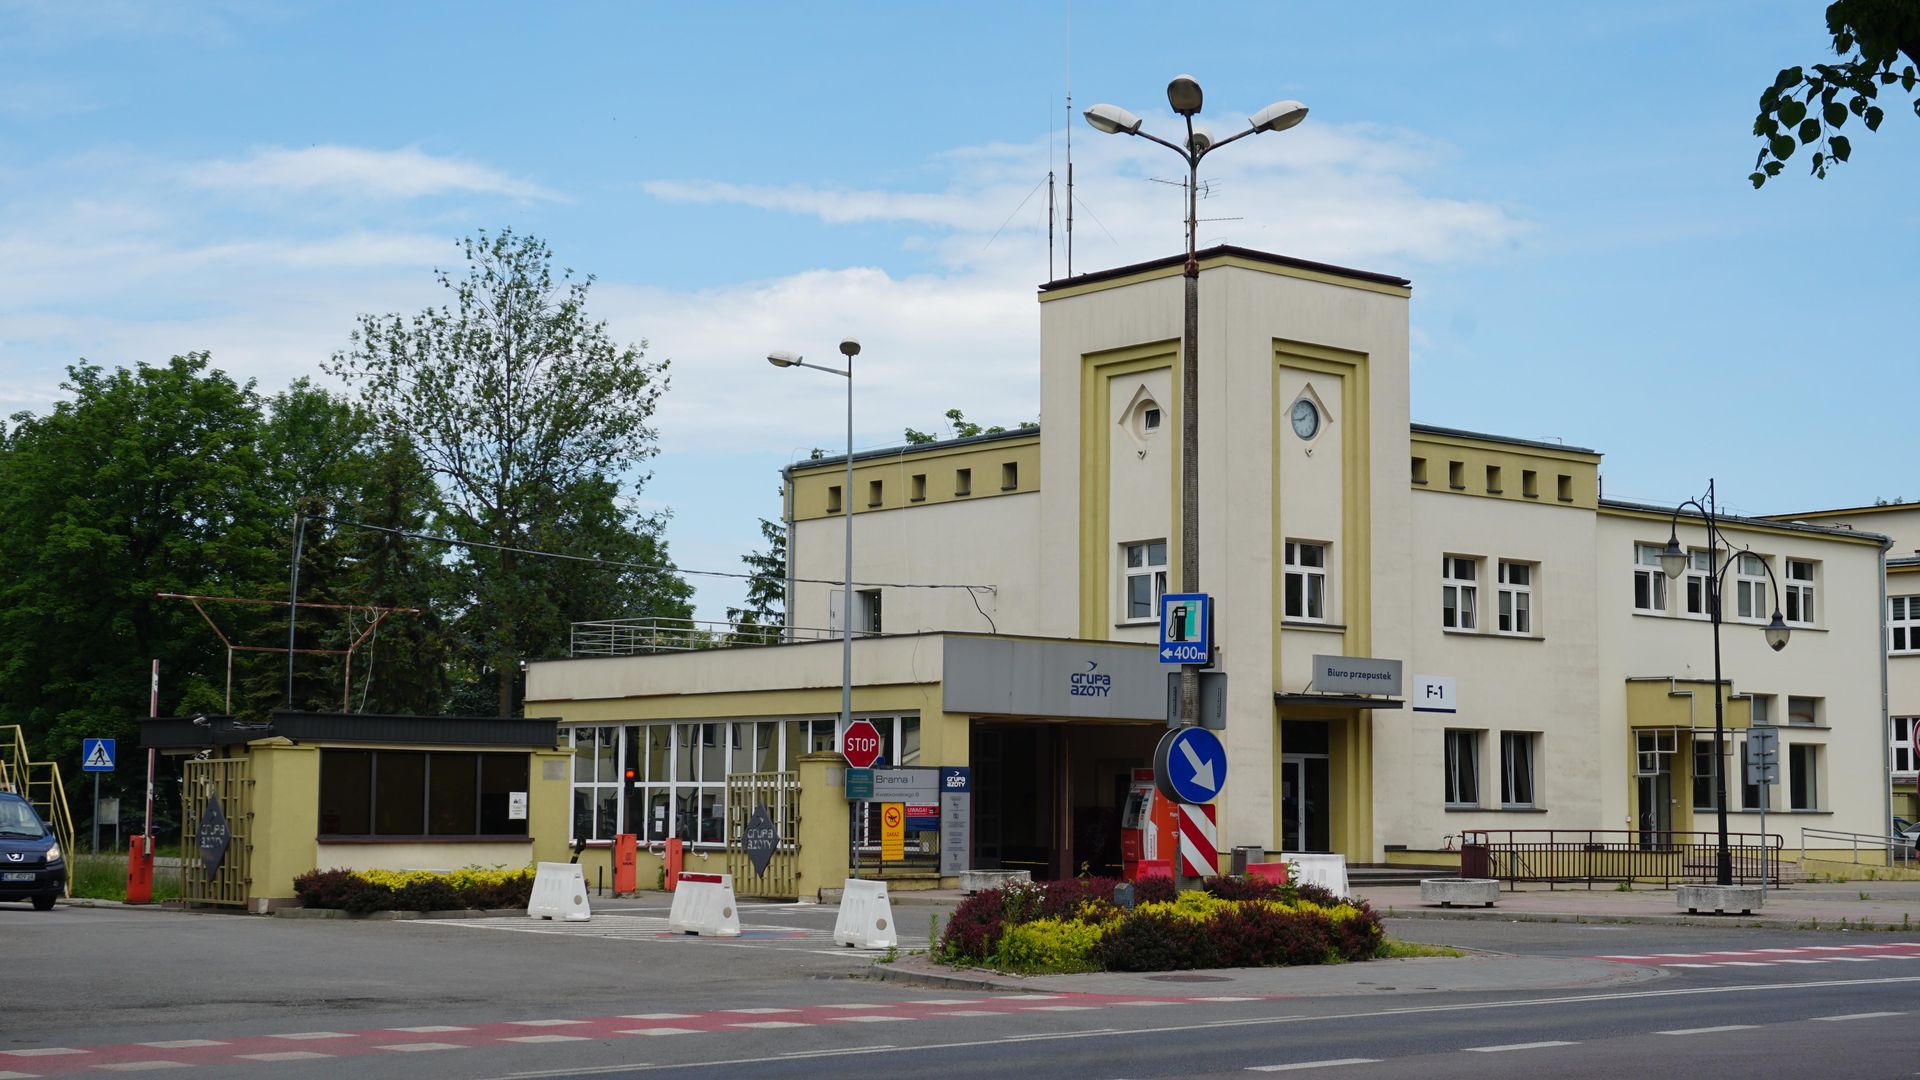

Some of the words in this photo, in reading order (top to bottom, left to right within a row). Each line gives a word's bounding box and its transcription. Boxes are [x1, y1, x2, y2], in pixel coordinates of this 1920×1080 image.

[1174, 646, 1206, 660] 400m
[1327, 668, 1348, 678] Biuro
[1350, 671, 1392, 681] przepustek
[1426, 685, 1443, 699] F-1
[847, 738, 877, 752] STOP
[875, 775, 908, 784] Brama
